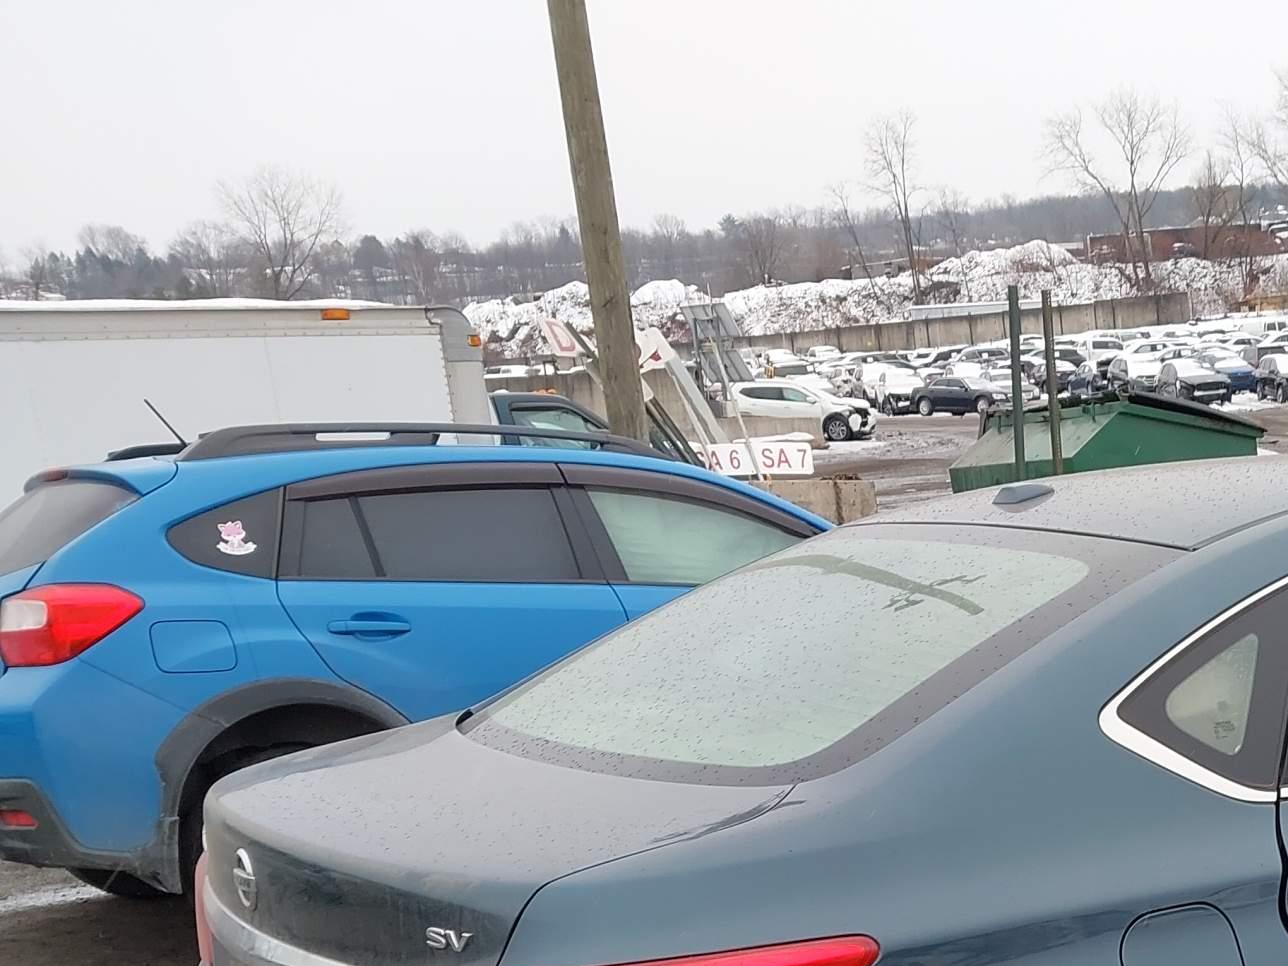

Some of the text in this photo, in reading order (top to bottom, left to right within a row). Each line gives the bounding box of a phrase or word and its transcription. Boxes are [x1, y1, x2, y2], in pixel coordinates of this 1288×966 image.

[729, 449, 741, 470] 6
[761, 448, 808, 469] SA 7
[426, 926, 474, 953] SV
